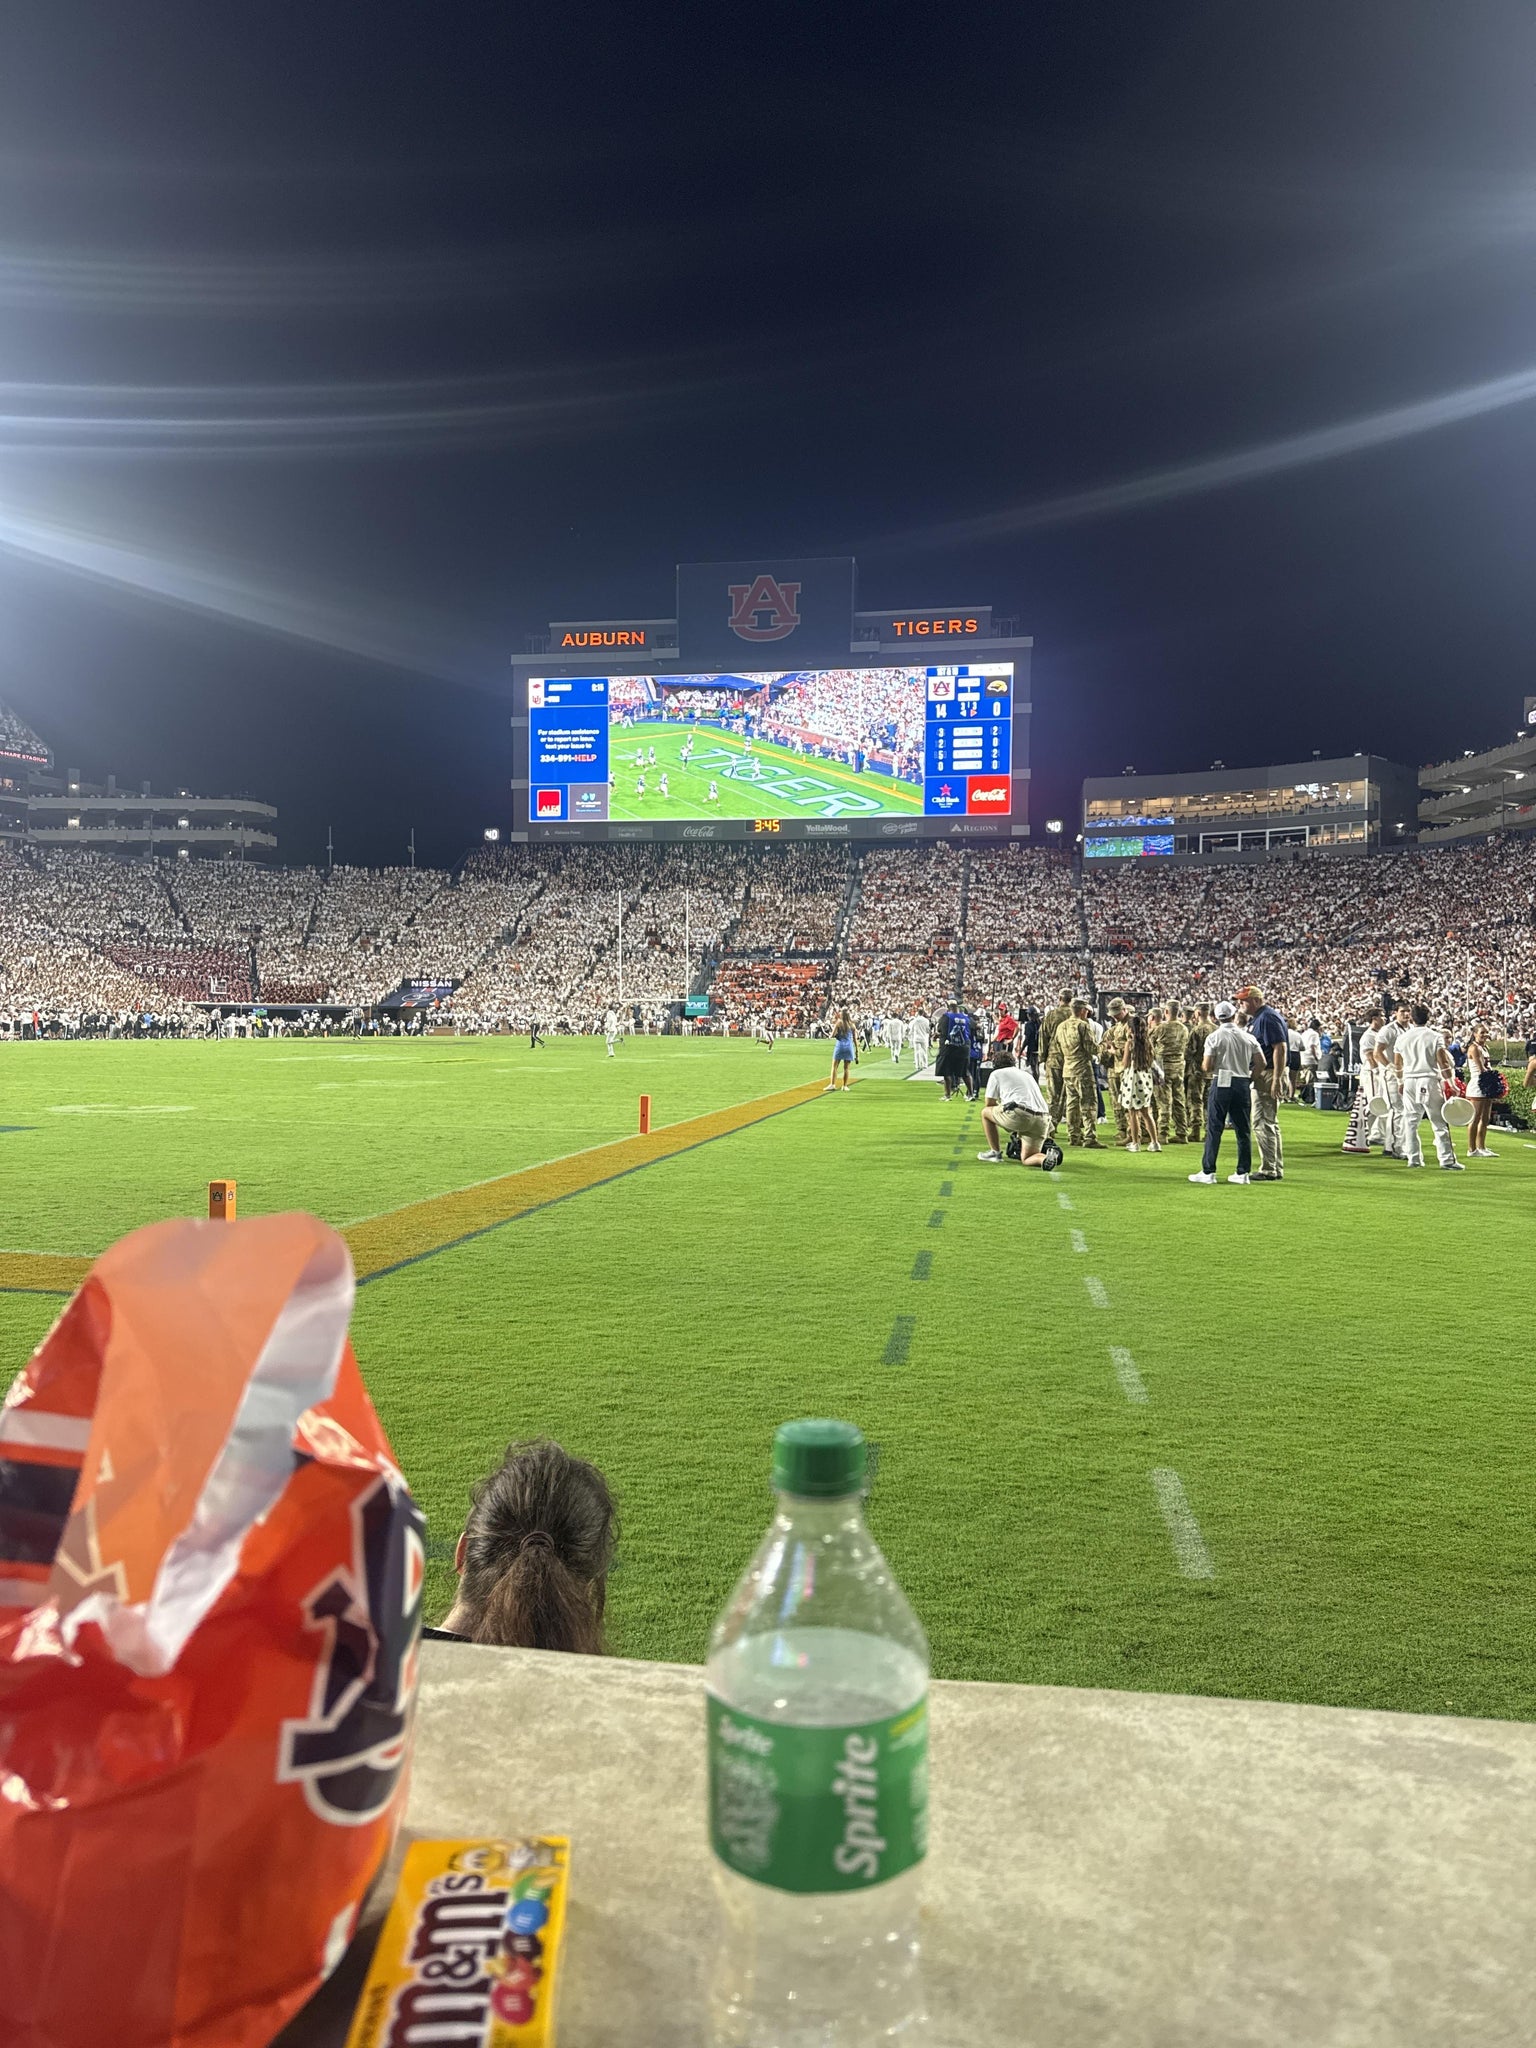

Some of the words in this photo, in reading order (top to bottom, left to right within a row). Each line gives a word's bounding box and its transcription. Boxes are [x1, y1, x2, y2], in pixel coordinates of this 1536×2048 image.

[893, 619, 978, 636] TIGERS
[561, 631, 645, 647] AUBURN
[935, 703, 947, 718] 14
[993, 701, 1001, 716] 0
[992, 725, 998, 736] 2
[938, 739, 944, 749] 2
[22, 754, 48, 763] STADIUM
[938, 750, 944, 760] 5
[992, 748, 998, 758] 2
[754, 819, 780, 832] 3:45
[1047, 821, 1061, 832] 40
[485, 829, 498, 840] 40
[832, 1733, 887, 1878] Sprite
